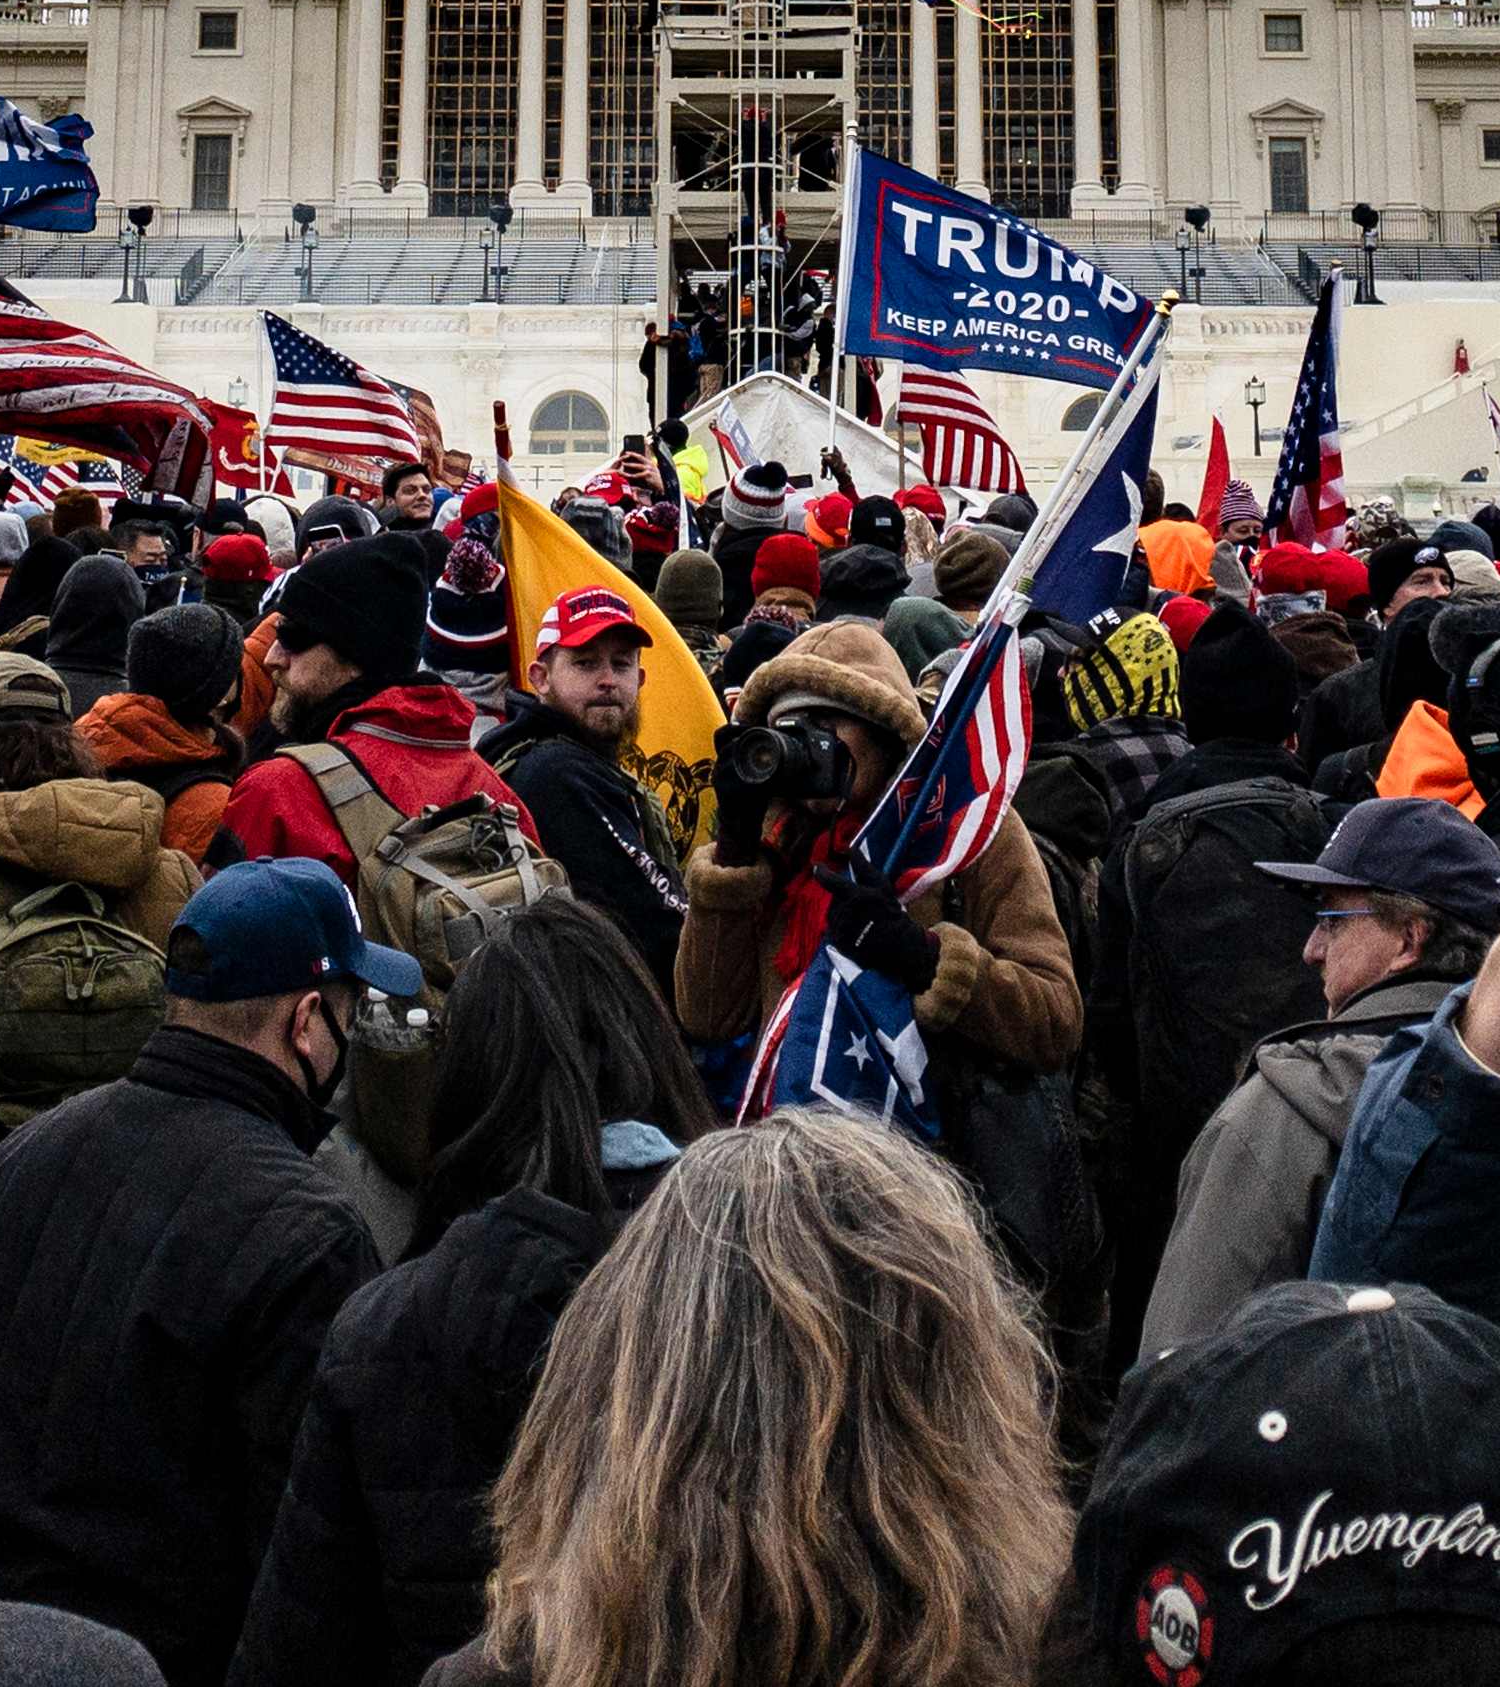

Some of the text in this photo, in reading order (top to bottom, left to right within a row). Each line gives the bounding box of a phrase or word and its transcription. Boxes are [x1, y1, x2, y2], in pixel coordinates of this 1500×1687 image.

[891, 200, 1137, 315] TRUMP
[886, 308, 947, 338] KEEP
[953, 317, 1061, 348] AMERICA
